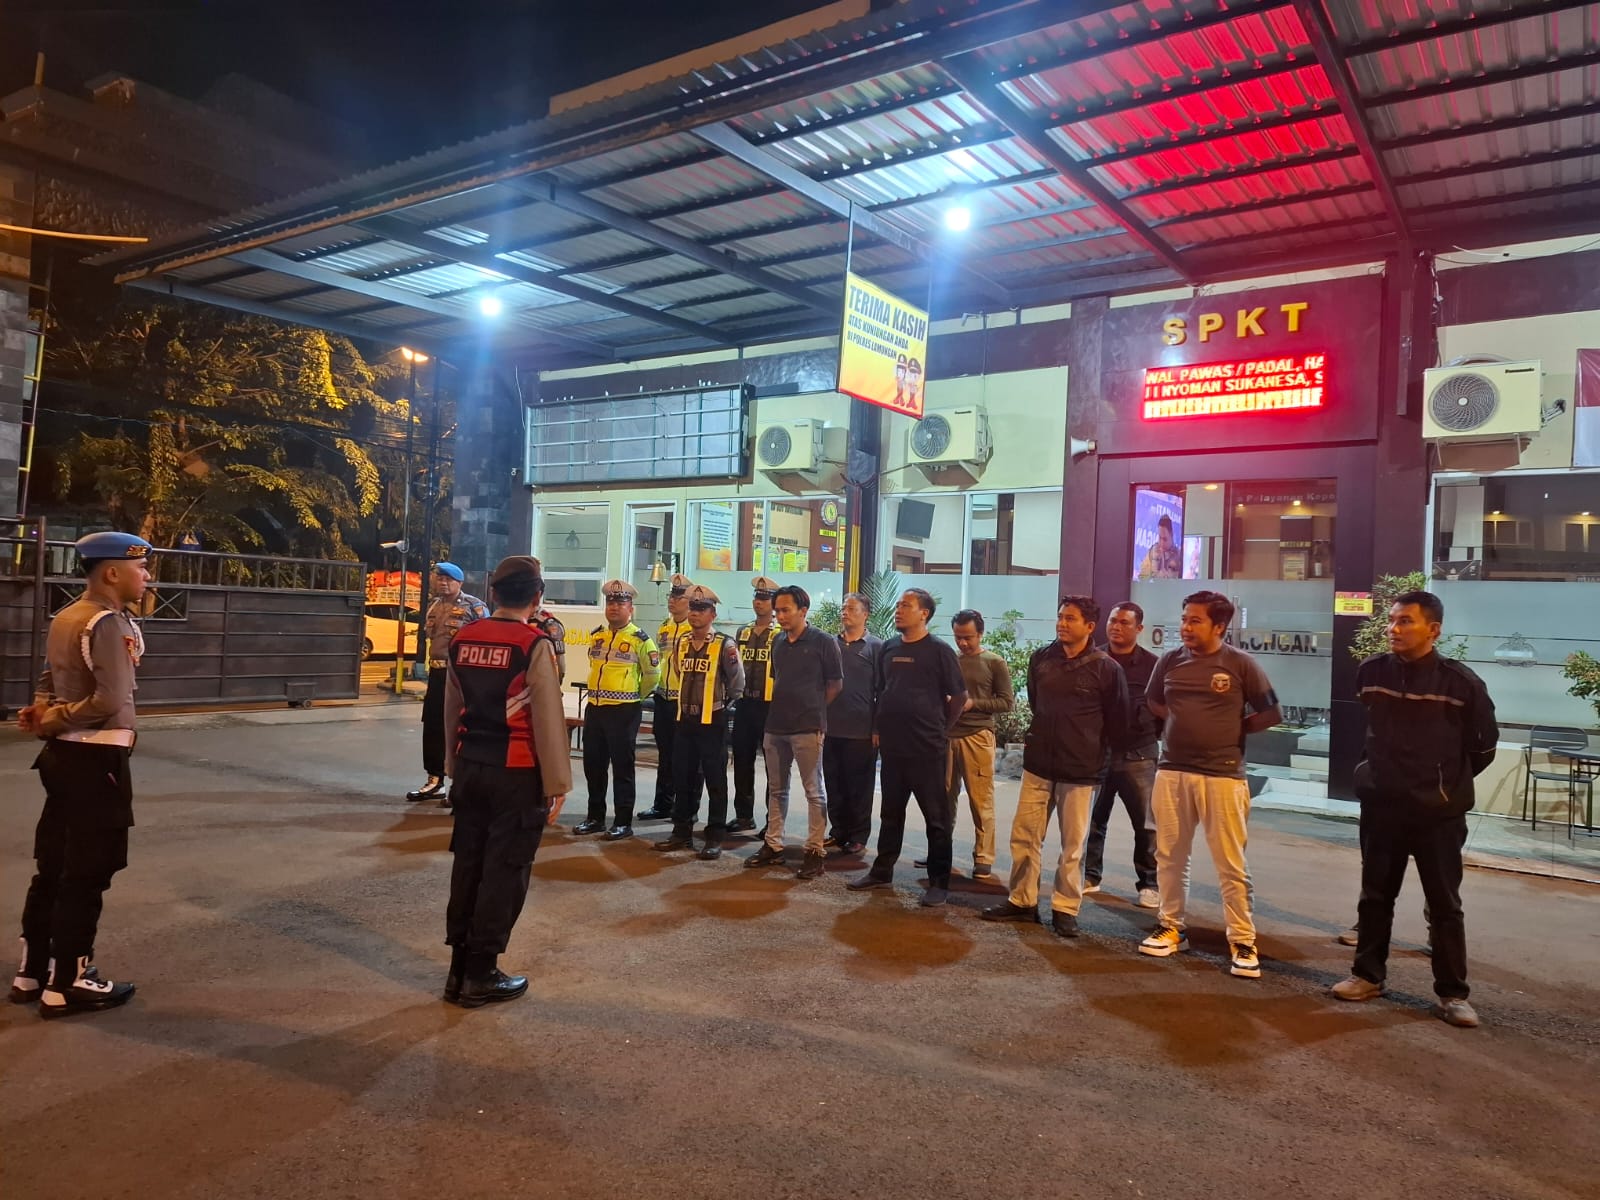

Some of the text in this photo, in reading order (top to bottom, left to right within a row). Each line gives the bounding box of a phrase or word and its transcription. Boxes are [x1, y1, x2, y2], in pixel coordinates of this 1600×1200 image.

[848, 314, 862, 329] ATAS
[849, 285, 927, 341] TERIMA KASIH
[1162, 302, 1308, 345] SPKT
[1180, 364, 1234, 381] PAWAS
[1161, 380, 1221, 397] NYOMAN
[1246, 494, 1303, 503] Playanan
[459, 646, 509, 666] POLISI
[742, 649, 770, 660] POLISI
[681, 659, 711, 671] POLISI
